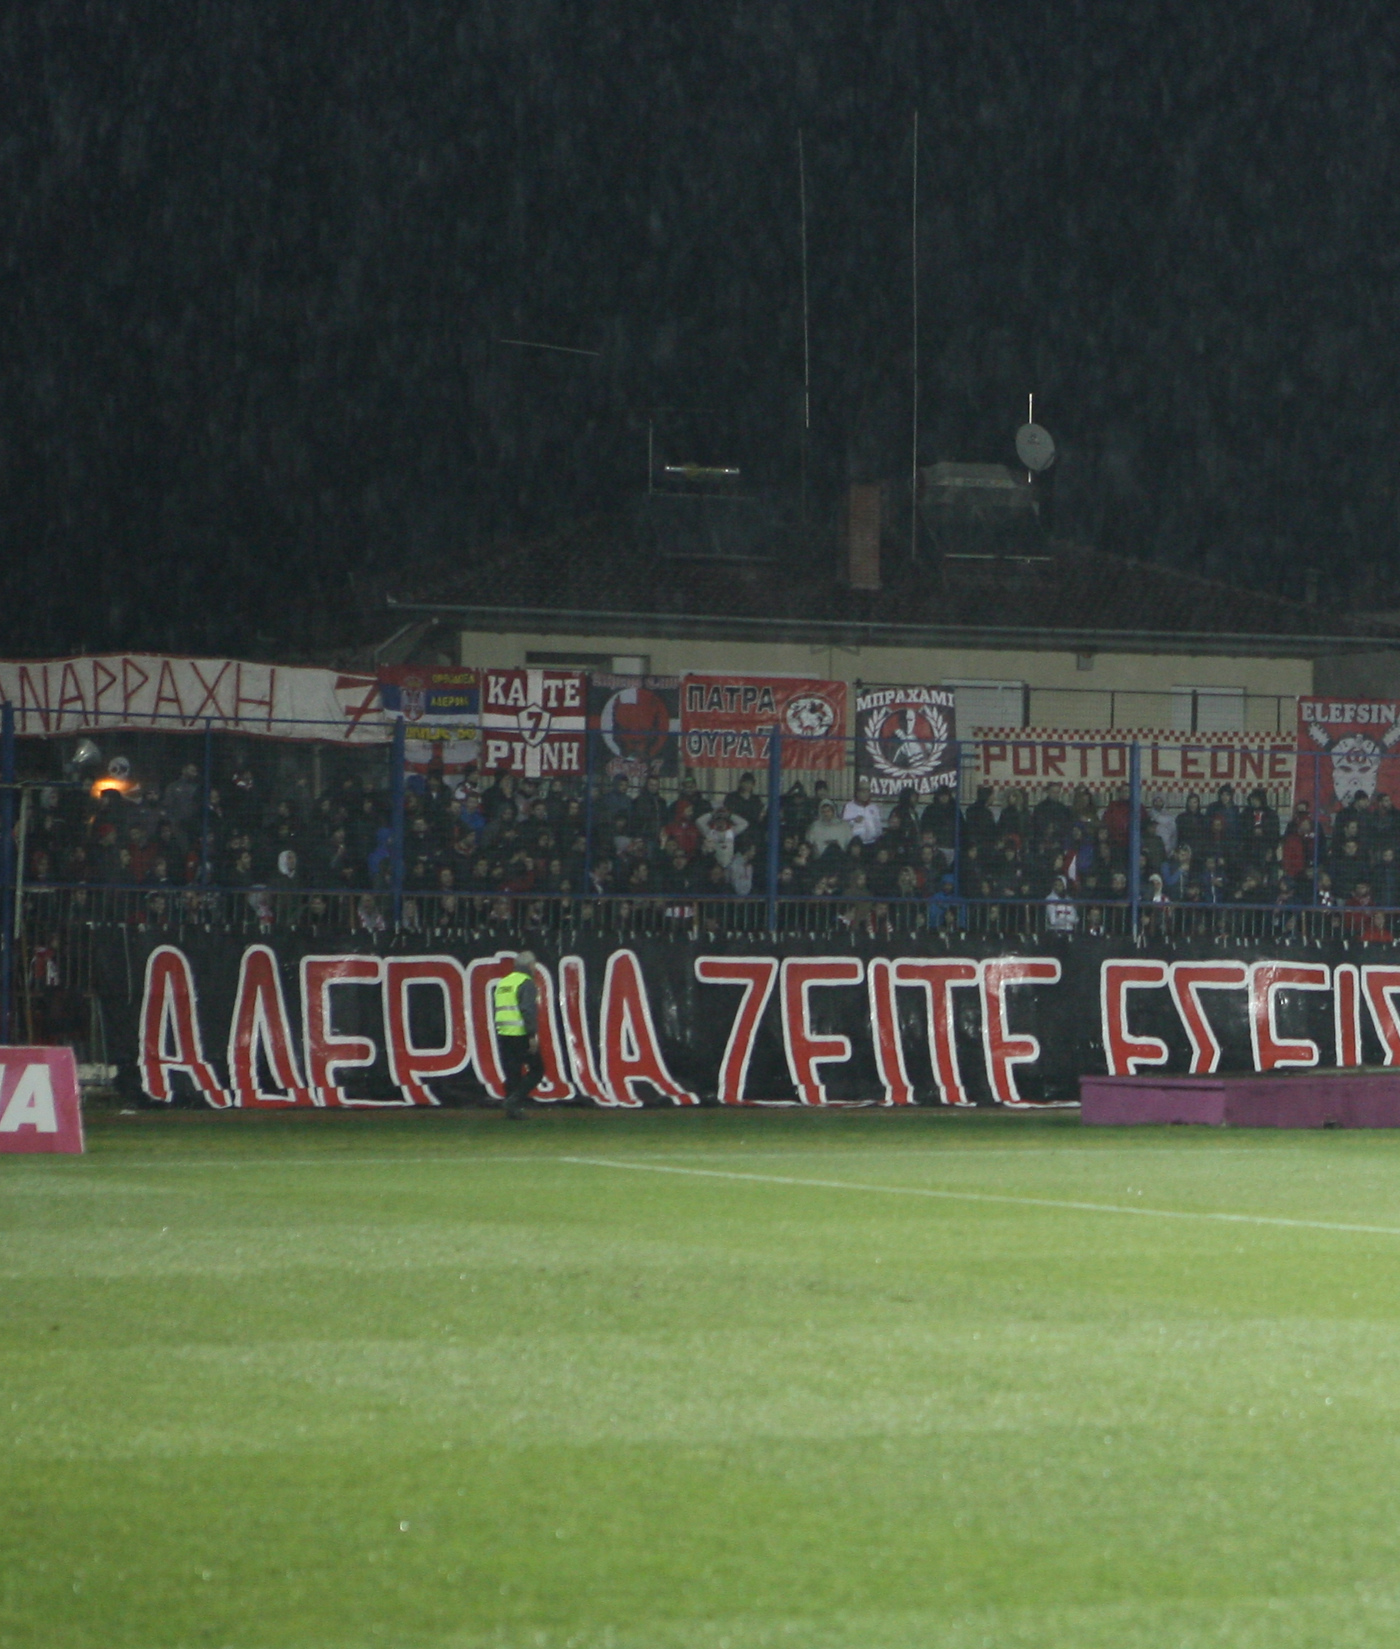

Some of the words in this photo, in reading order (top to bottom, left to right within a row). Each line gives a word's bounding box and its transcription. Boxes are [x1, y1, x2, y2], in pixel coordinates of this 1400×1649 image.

[686, 684, 777, 713] ΠΑΤΡΑ
[856, 689, 955, 712] ΜΠΡΑΧΑΜΙ
[527, 712, 543, 740] 7
[686, 728, 756, 758] ΘΥΡΑ
[982, 741, 1126, 777] PORTO
[1150, 742, 1294, 779] LEONE
[0, 1063, 58, 1132] A
